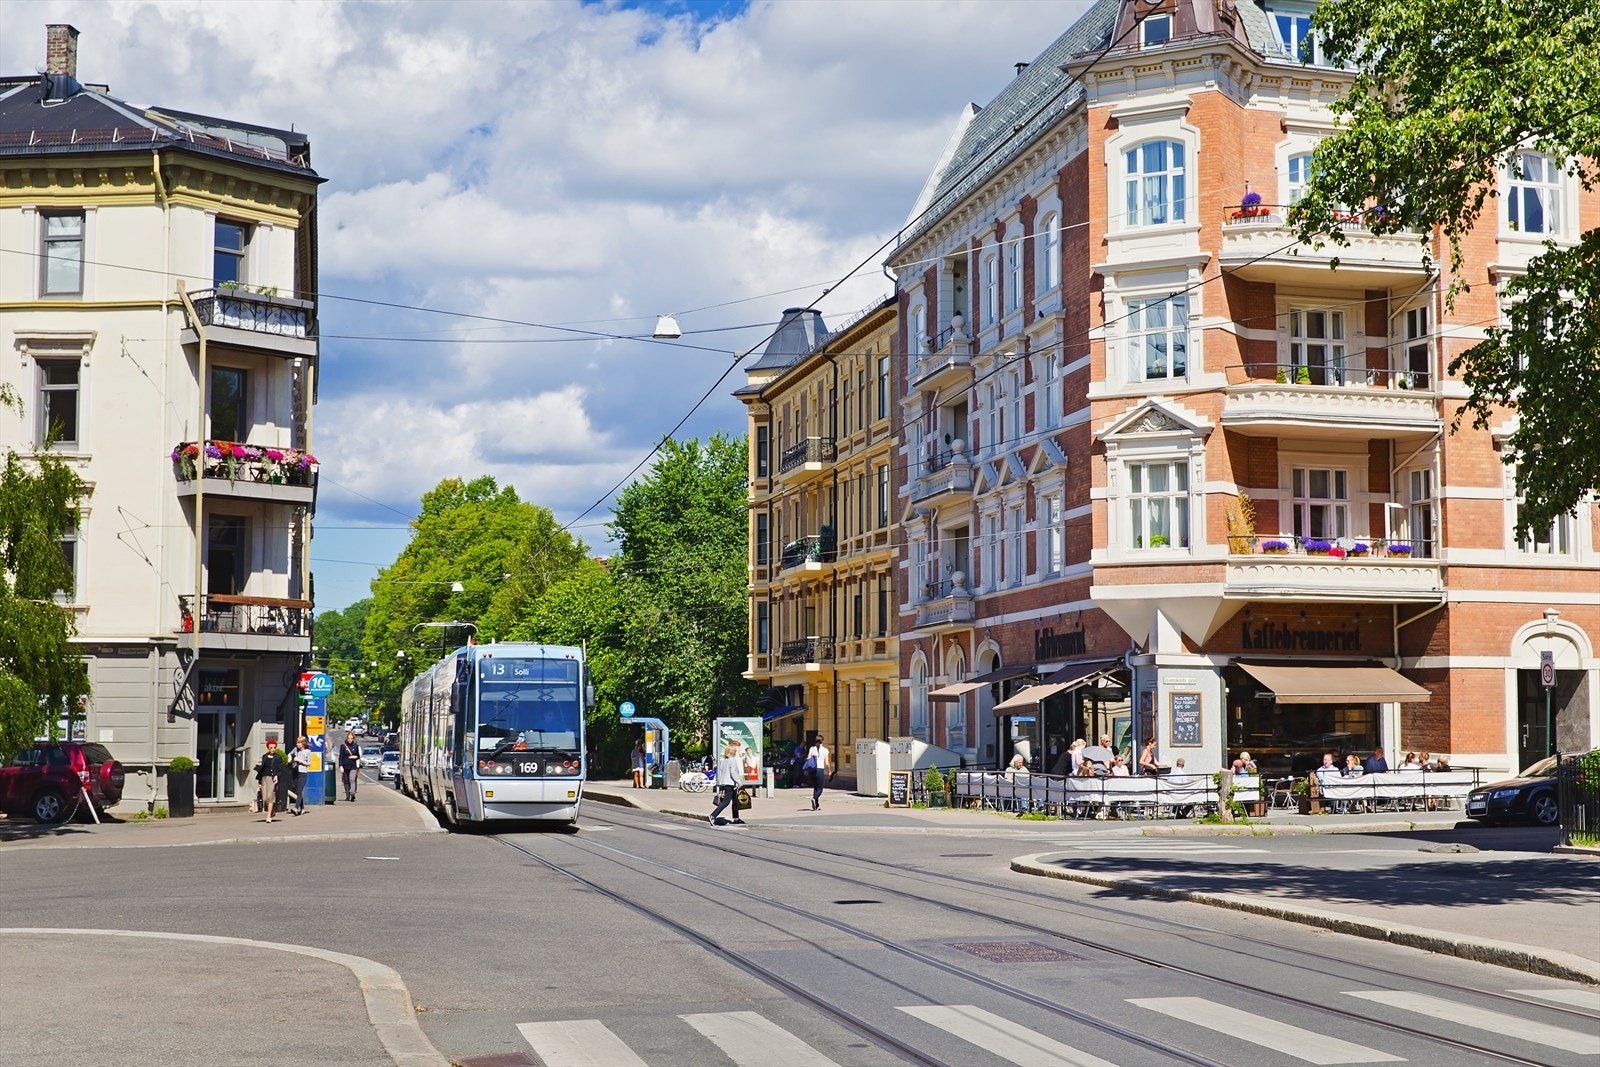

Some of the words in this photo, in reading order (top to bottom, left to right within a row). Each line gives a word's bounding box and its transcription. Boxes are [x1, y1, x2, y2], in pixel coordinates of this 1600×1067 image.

[1242, 622, 1361, 650] Kaffebrenneriet
[492, 664, 505, 675] 13
[514, 668, 530, 676] Solli
[312, 677, 326, 688] 10
[519, 762, 538, 773] 169
